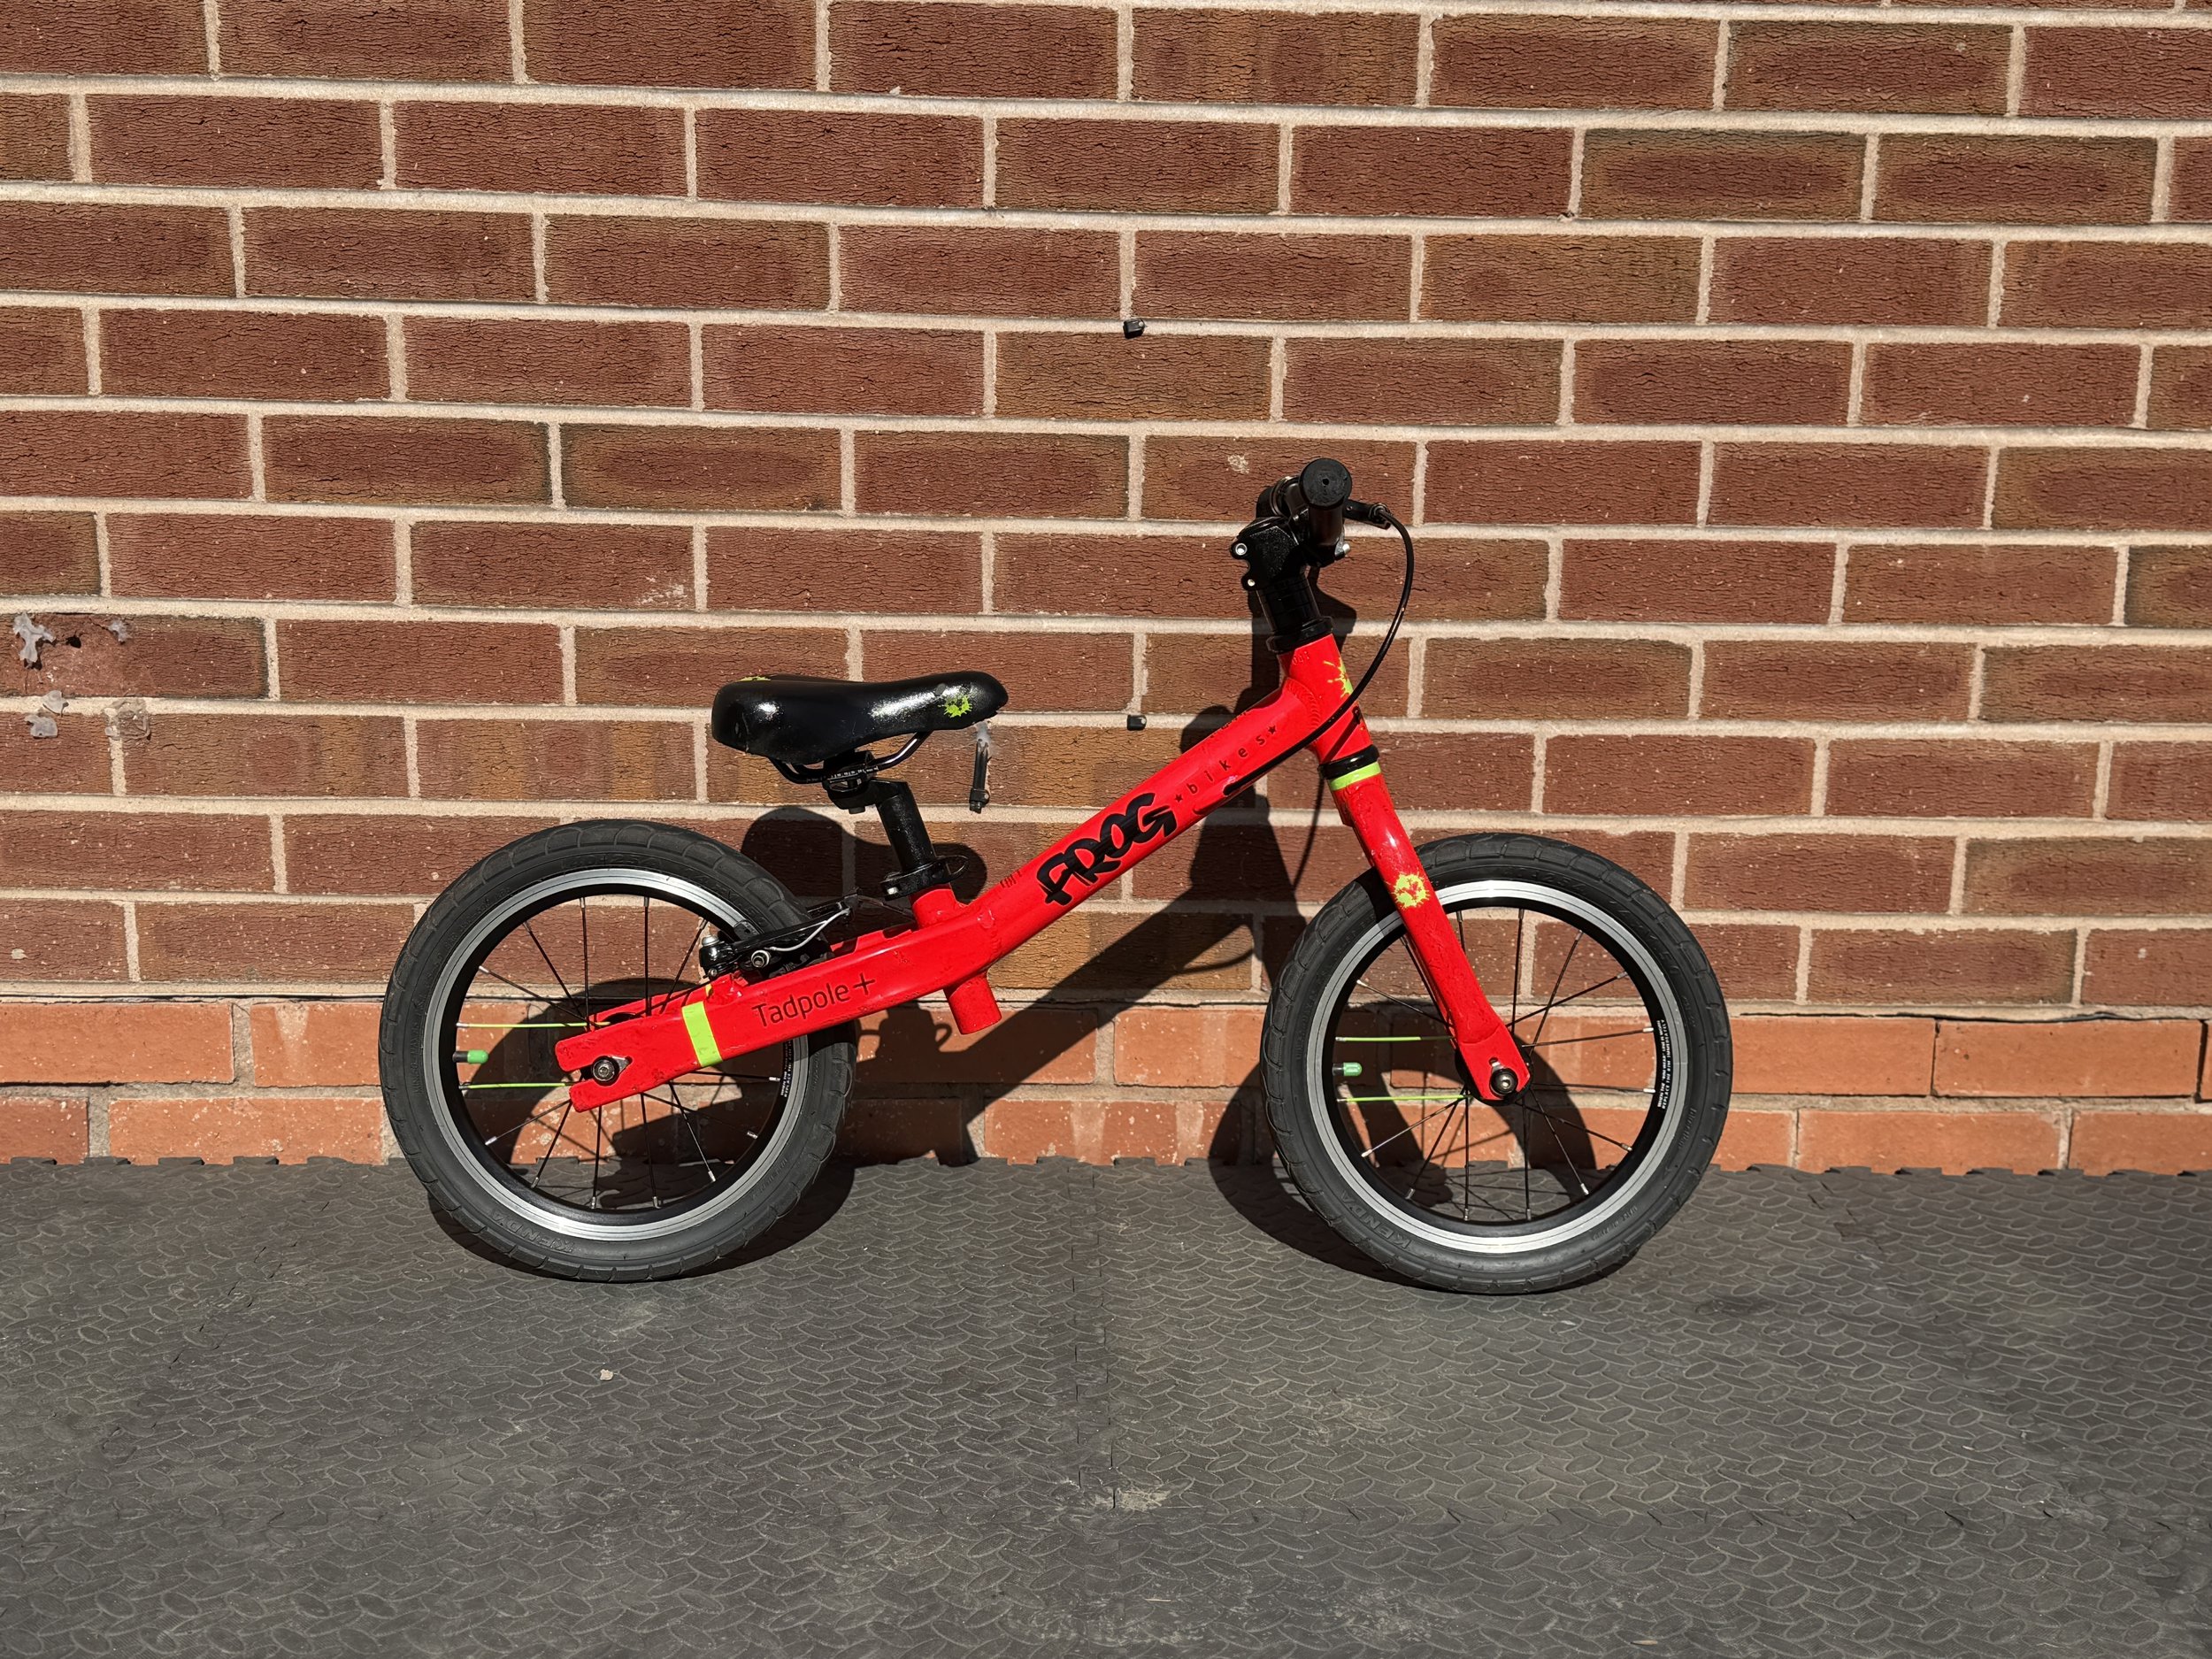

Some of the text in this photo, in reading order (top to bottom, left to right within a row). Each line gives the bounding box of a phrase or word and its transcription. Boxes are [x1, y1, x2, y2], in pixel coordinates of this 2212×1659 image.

[1188, 735, 1264, 795] bikes
[1036, 793, 1178, 906] FROG
[751, 983, 849, 1027] Tadpole
[491, 1208, 574, 1254] KENDA
[1340, 1190, 1413, 1251] KENDA
